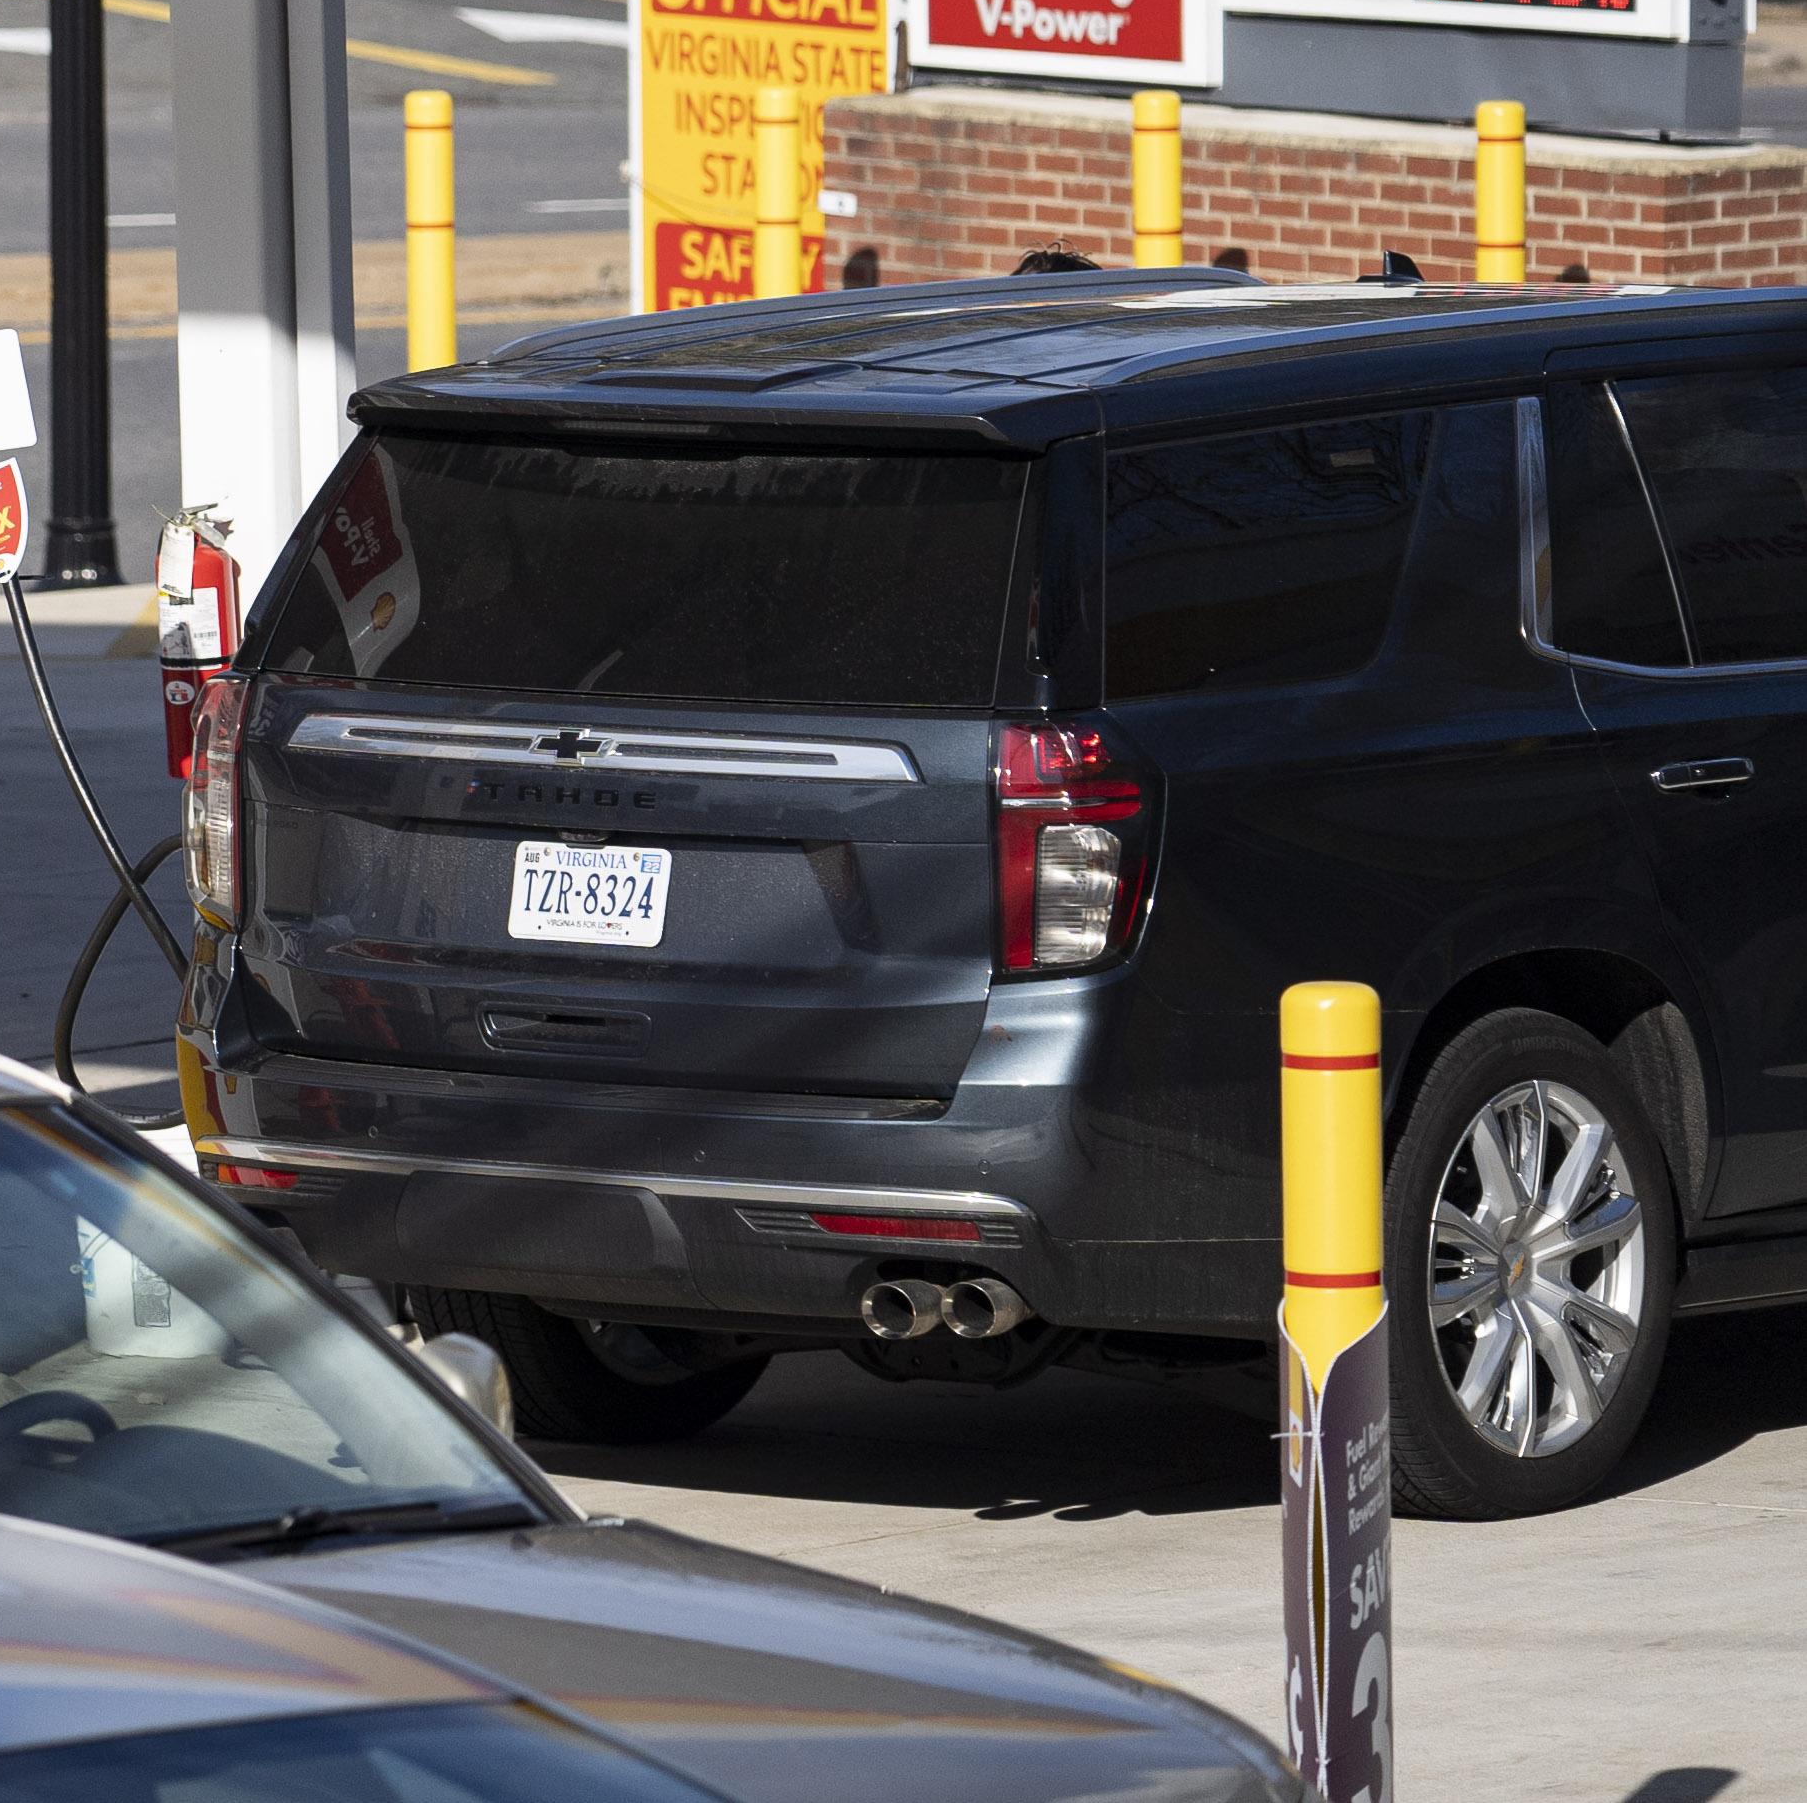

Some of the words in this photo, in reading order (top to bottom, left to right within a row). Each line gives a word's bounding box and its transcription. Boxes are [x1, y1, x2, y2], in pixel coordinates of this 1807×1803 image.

[645, 28, 784, 82] VIRGINIA
[791, 41, 885, 92] STATE
[483, 782, 657, 811] TAHOE
[524, 852, 540, 863] AUG
[556, 850, 627, 869] VIRGINIA
[644, 861, 660, 872] 22
[524, 868, 654, 919] TZR-8324
[547, 918, 575, 927] VIRGINIA
[583, 921, 596, 929] FOR
[1346, 1426, 1368, 1469] Fuel
[1347, 1473, 1357, 1502] &
[1350, 1534, 1390, 1630] SAV
